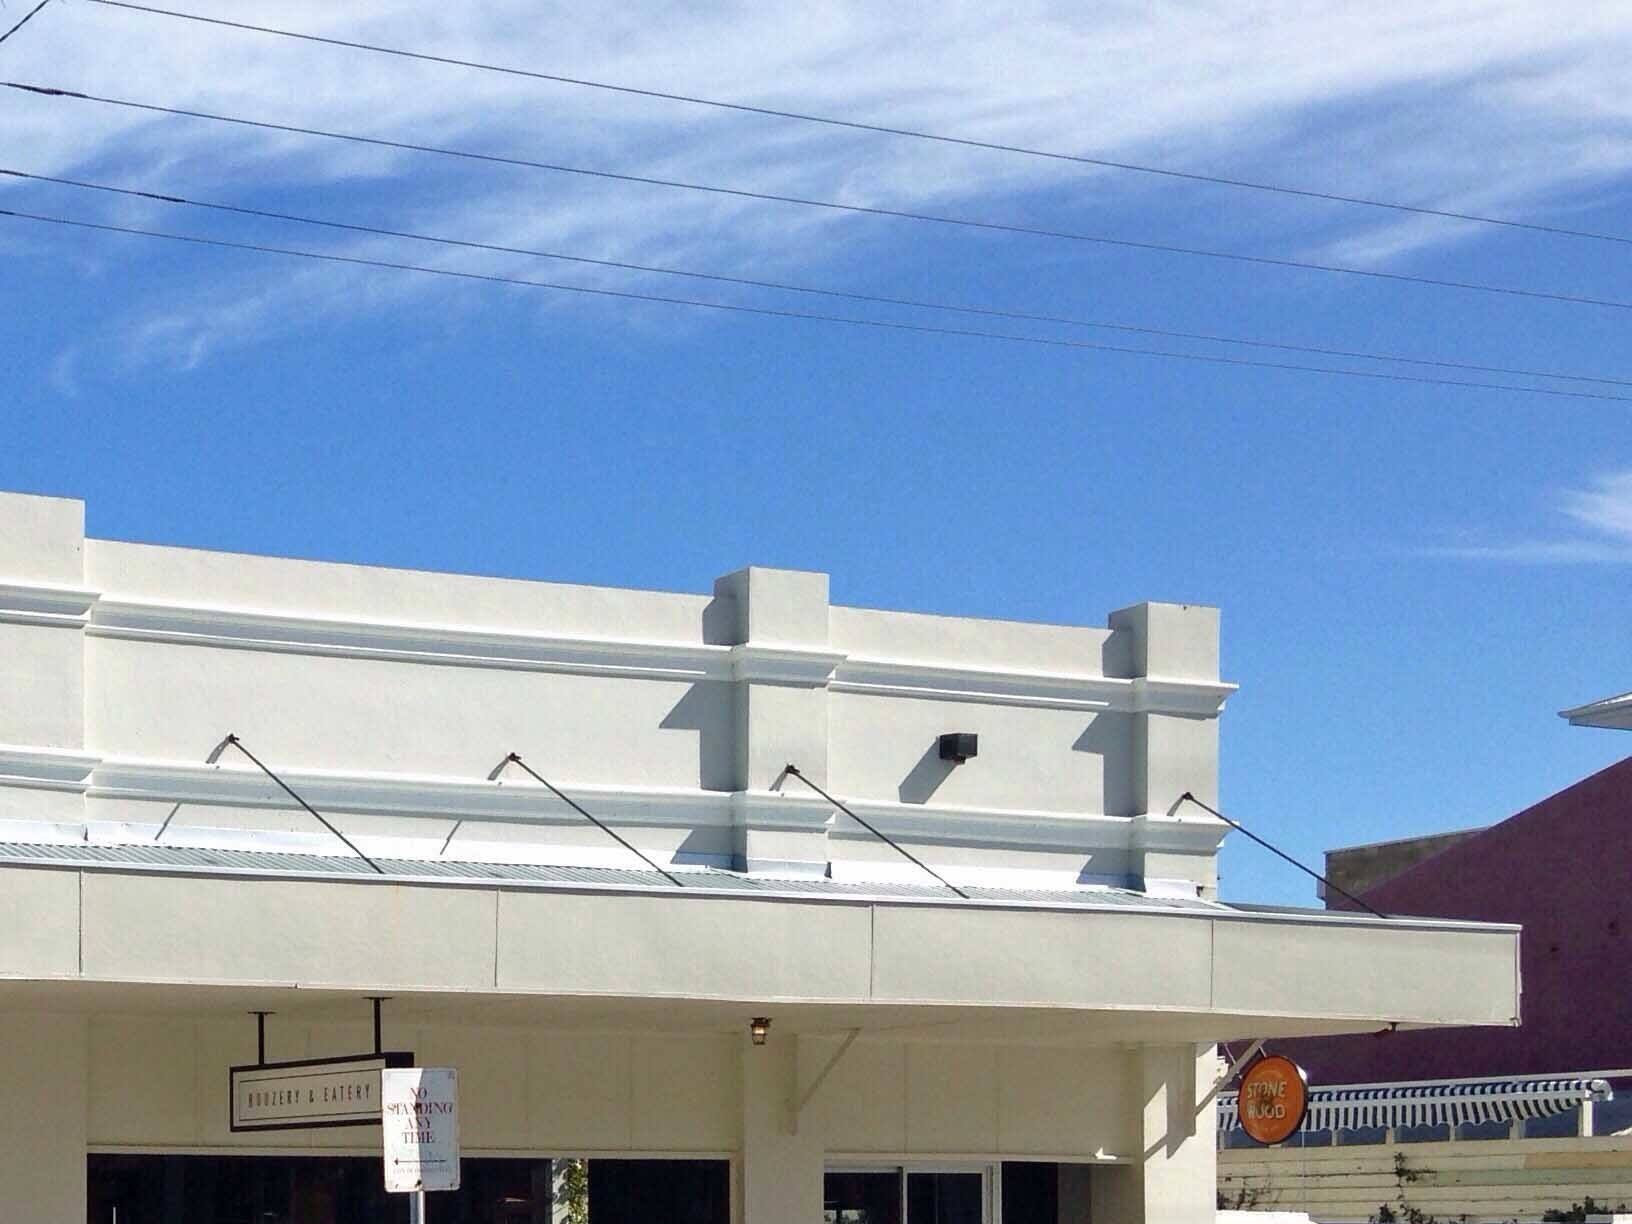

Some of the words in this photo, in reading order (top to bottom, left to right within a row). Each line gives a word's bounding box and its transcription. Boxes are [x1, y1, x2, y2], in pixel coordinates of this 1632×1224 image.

[248, 1089, 300, 1108] BOOZERY
[323, 1083, 371, 1103] EATERY
[410, 1087, 428, 1099] NO
[1247, 1081, 1287, 1098] STONE
[387, 1101, 453, 1116] STANDING
[1247, 1103, 1286, 1119] WOOD
[405, 1116, 432, 1130] ANY
[401, 1131, 435, 1145] TIME
